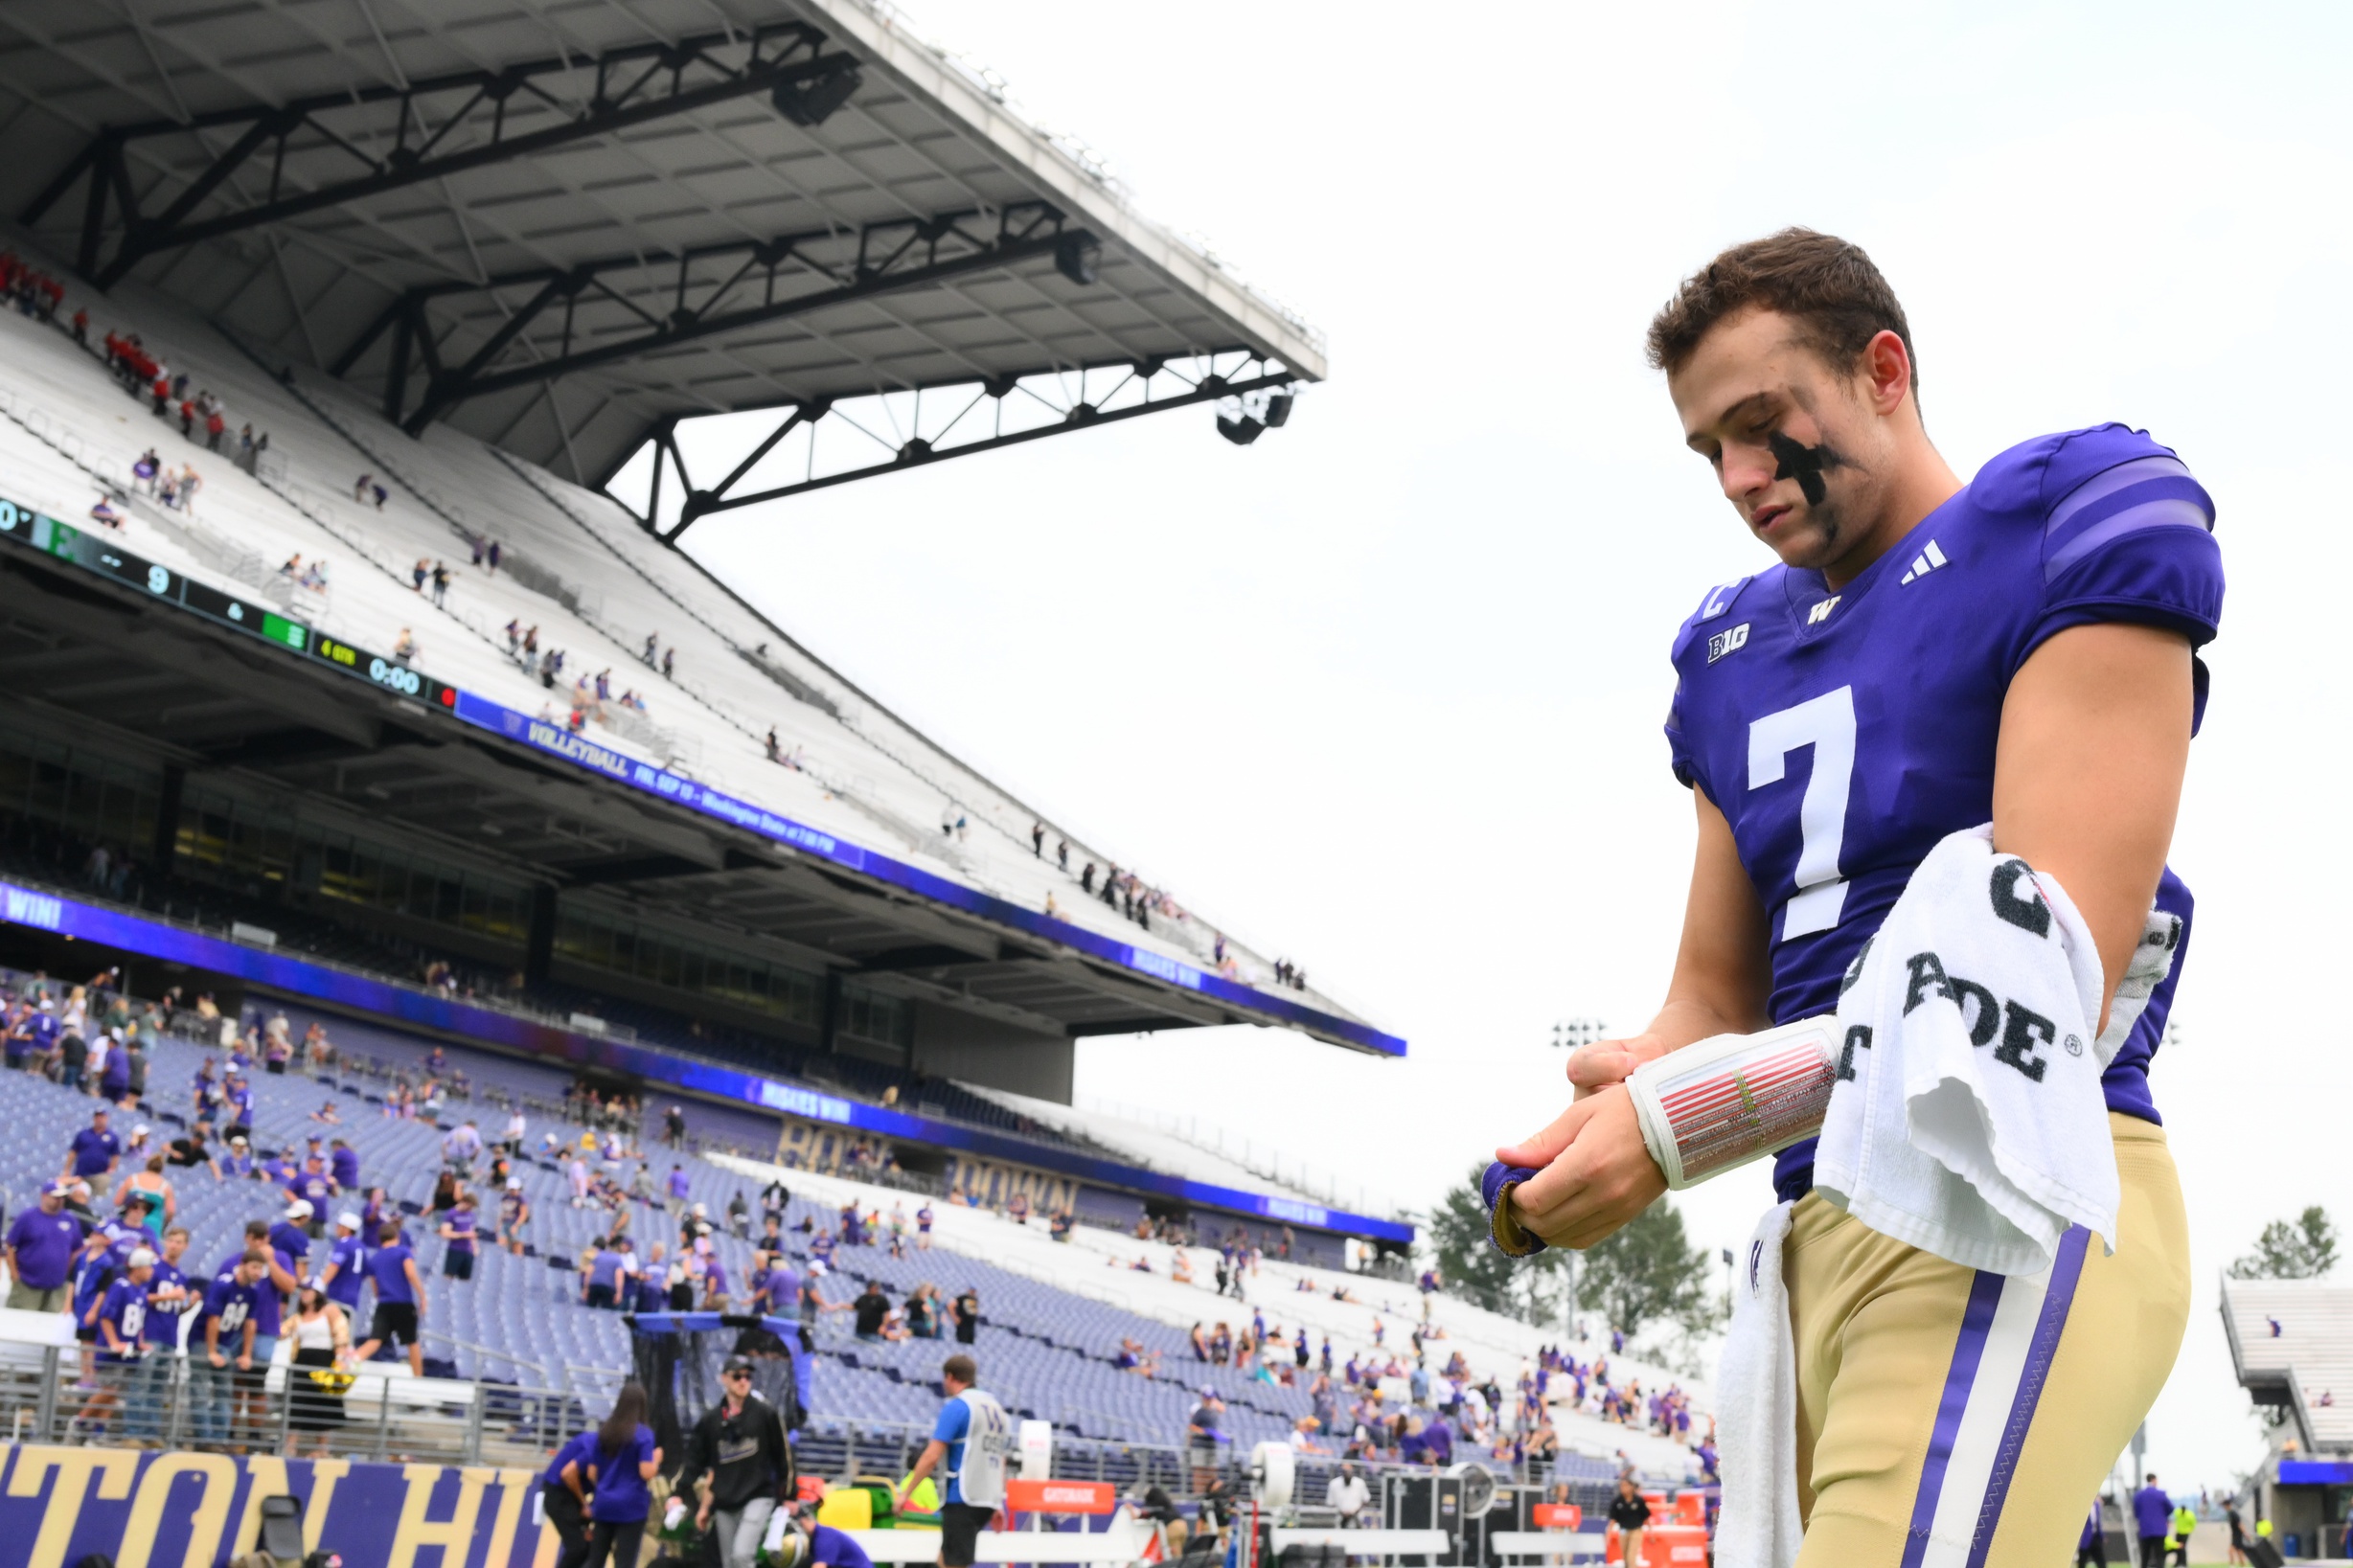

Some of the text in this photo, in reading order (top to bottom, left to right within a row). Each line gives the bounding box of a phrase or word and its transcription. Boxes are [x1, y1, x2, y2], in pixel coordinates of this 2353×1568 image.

[147, 565, 171, 594] 9
[1808, 595, 1842, 625] W
[369, 658, 420, 695] 0:00
[528, 720, 629, 778] VOLLEYBALL
[1747, 684, 1858, 942] 7
